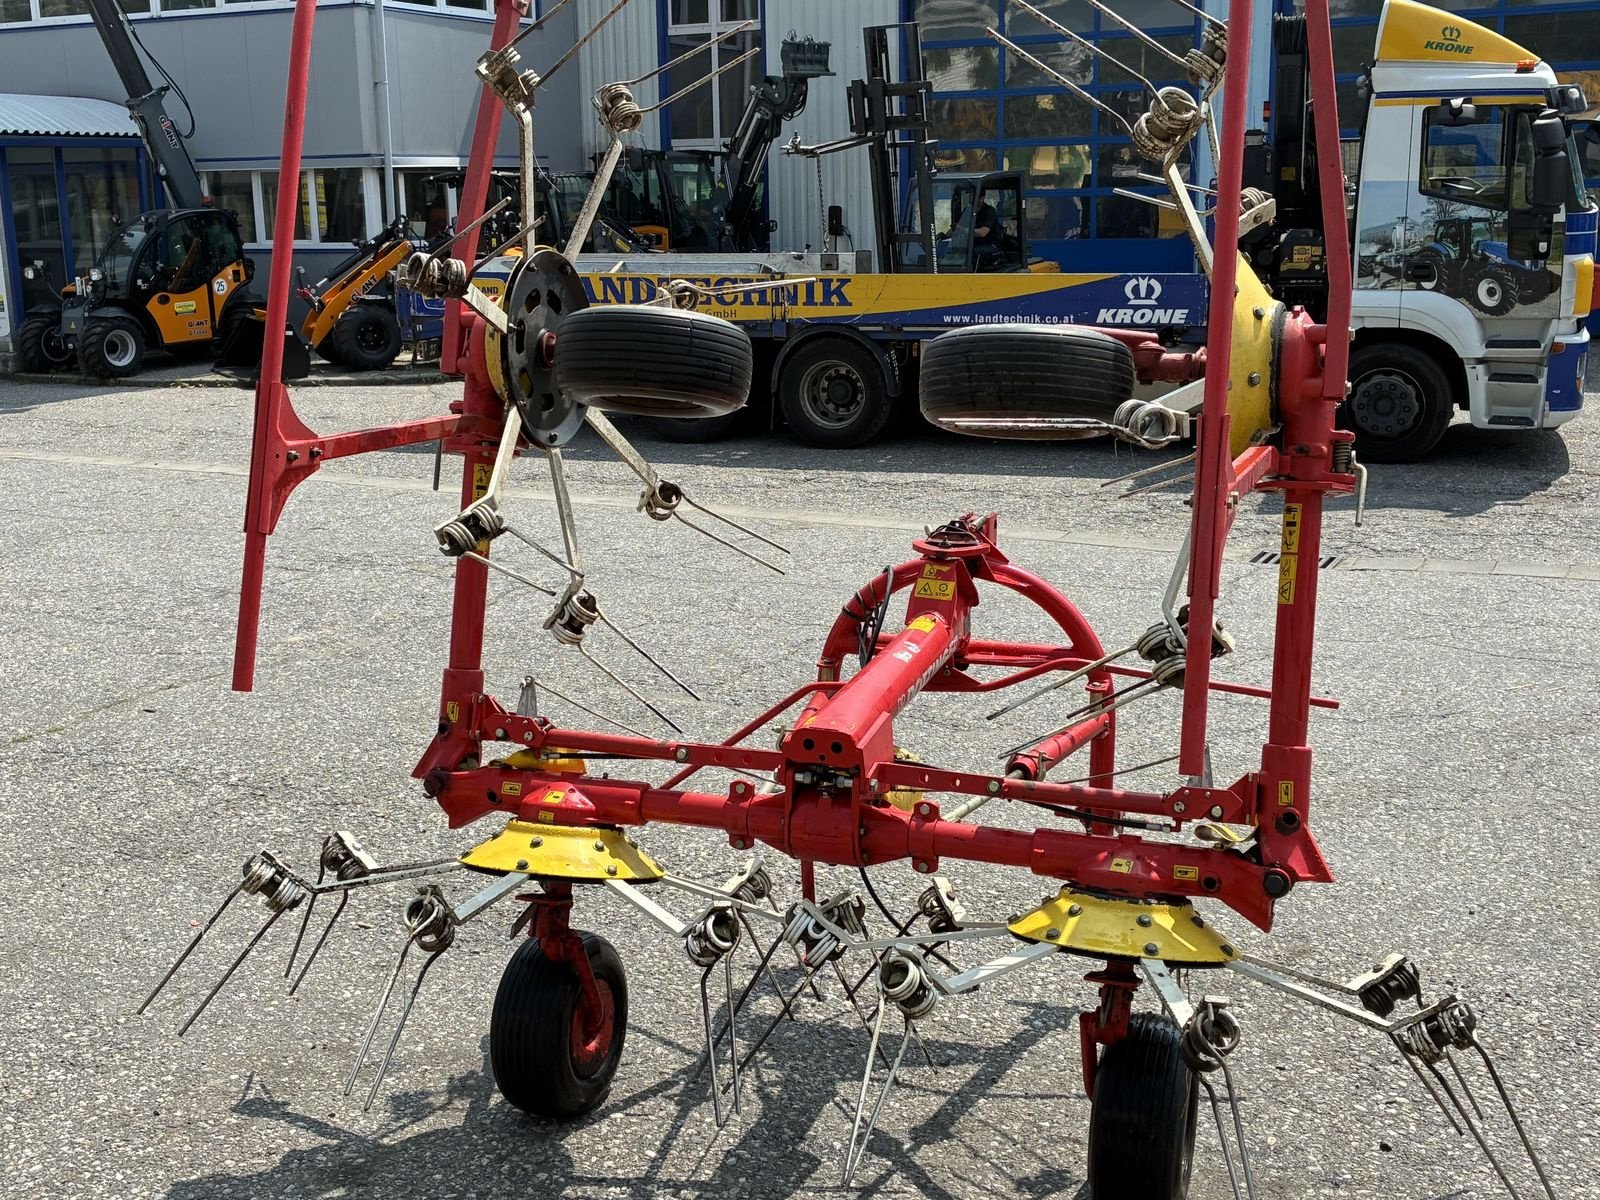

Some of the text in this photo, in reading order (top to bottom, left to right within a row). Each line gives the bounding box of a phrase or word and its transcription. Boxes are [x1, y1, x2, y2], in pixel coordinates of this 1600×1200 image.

[1424, 40, 1474, 54] KRONE
[216, 281, 225, 292] 25
[477, 286, 498, 294] AND
[943, 314, 1075, 324] www.landtechnik.co.at
[1096, 308, 1189, 324] KRONE
